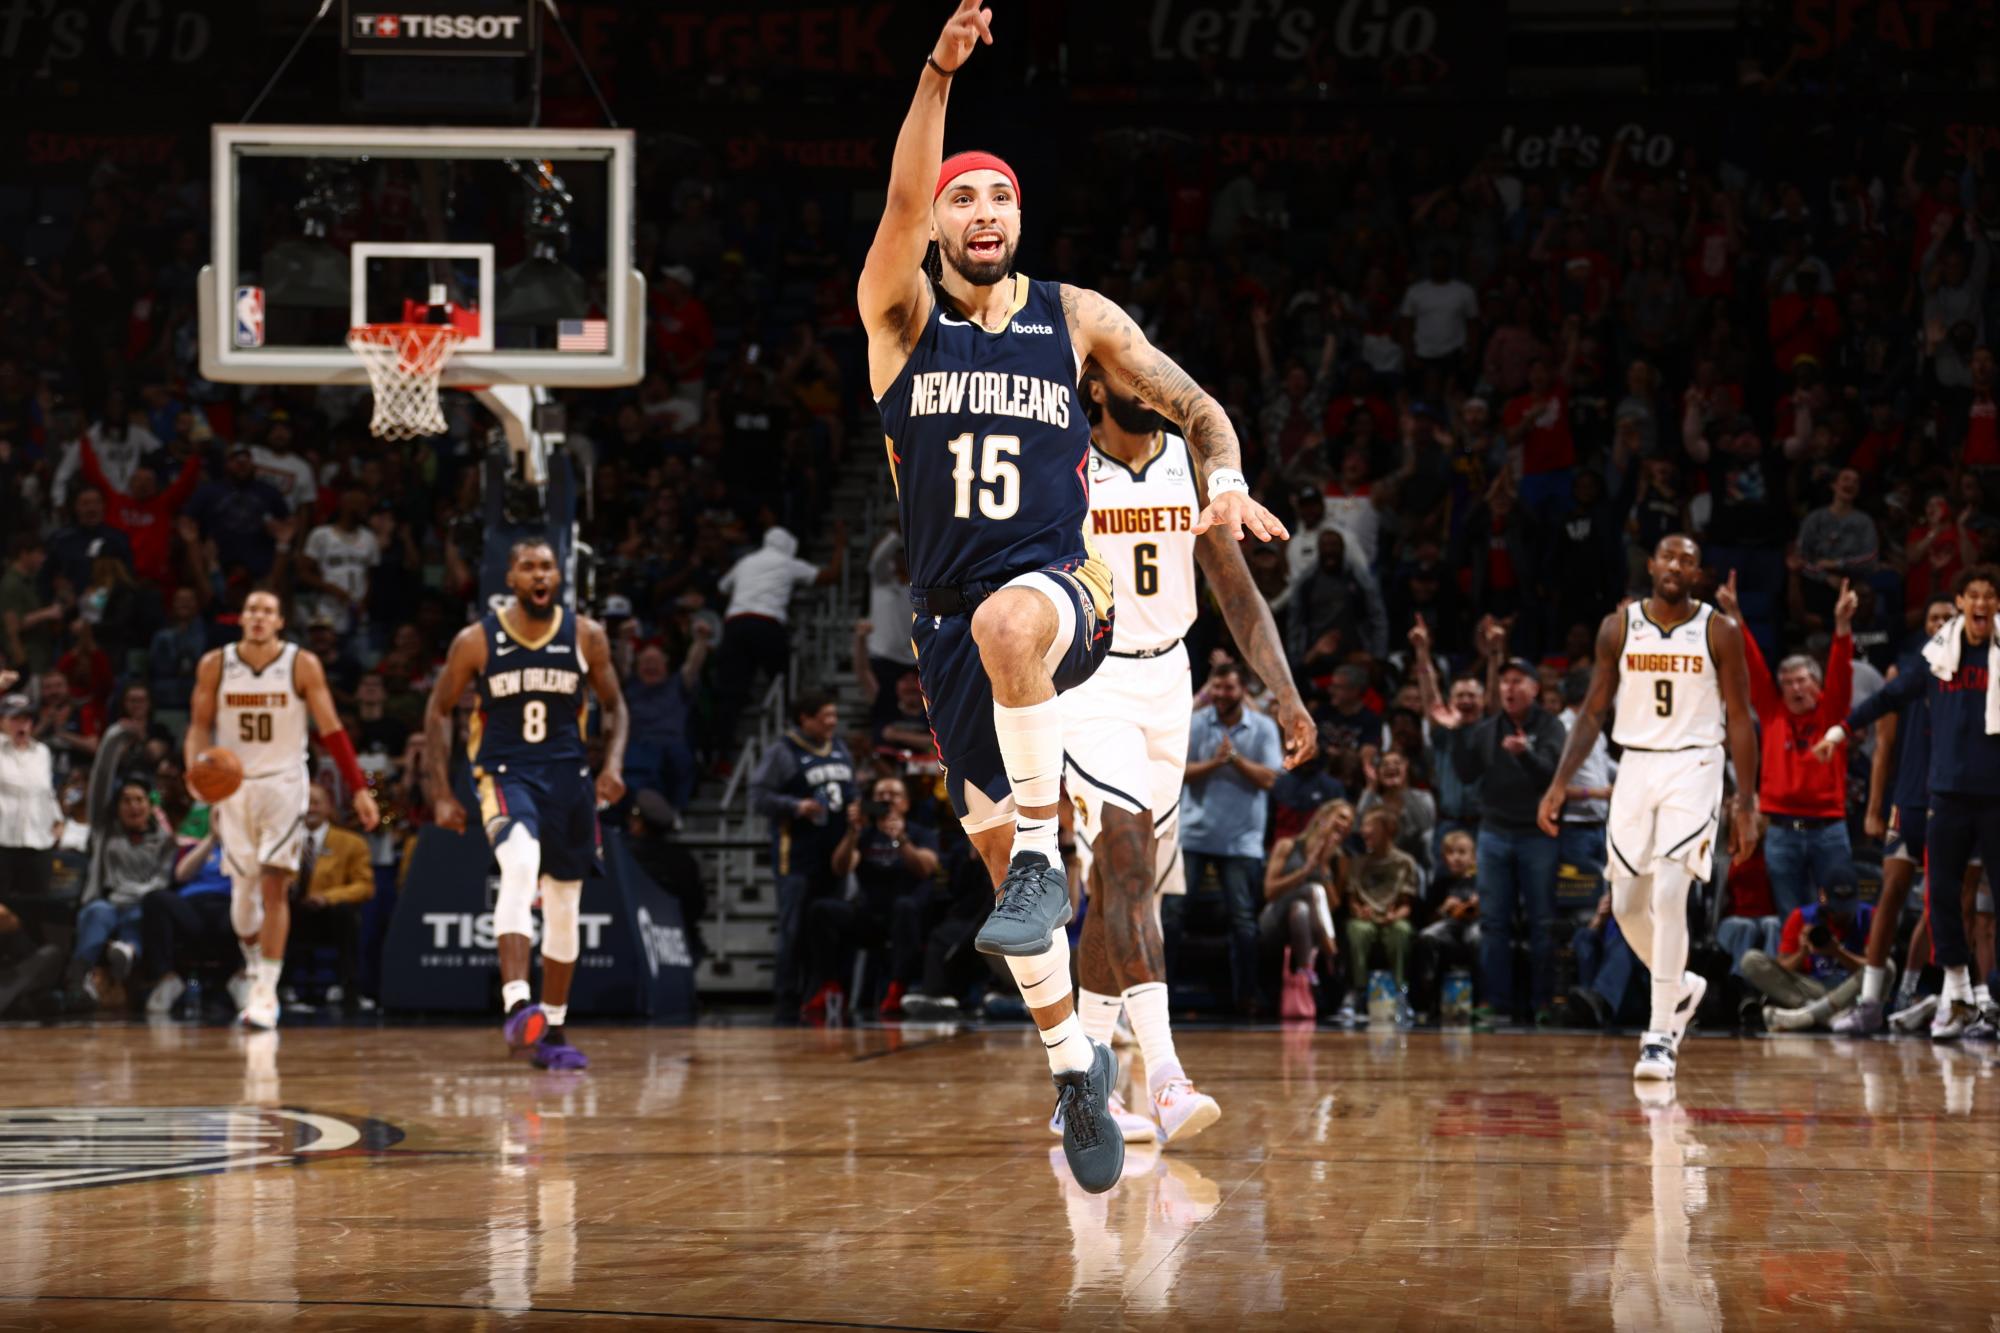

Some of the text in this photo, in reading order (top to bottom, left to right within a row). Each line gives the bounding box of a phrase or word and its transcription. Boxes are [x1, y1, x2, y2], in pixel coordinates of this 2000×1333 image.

[108, 0, 210, 62] Go
[401, 14, 522, 39] TISSOT
[541, 2, 897, 78] SETGEEK
[1149, 0, 1438, 60] Let's Go
[1011, 321, 1053, 335] ibotta
[948, 432, 1021, 520] 15
[1091, 506, 1191, 535] NUGGETS
[1133, 541, 1159, 597] 6
[1626, 654, 1704, 673] NUGGETS
[488, 667, 580, 699] NEW ORLEANS
[1654, 679, 1673, 718] 9
[239, 712, 272, 743] 50
[523, 700, 547, 743] 8
[422, 912, 612, 949] TIST
